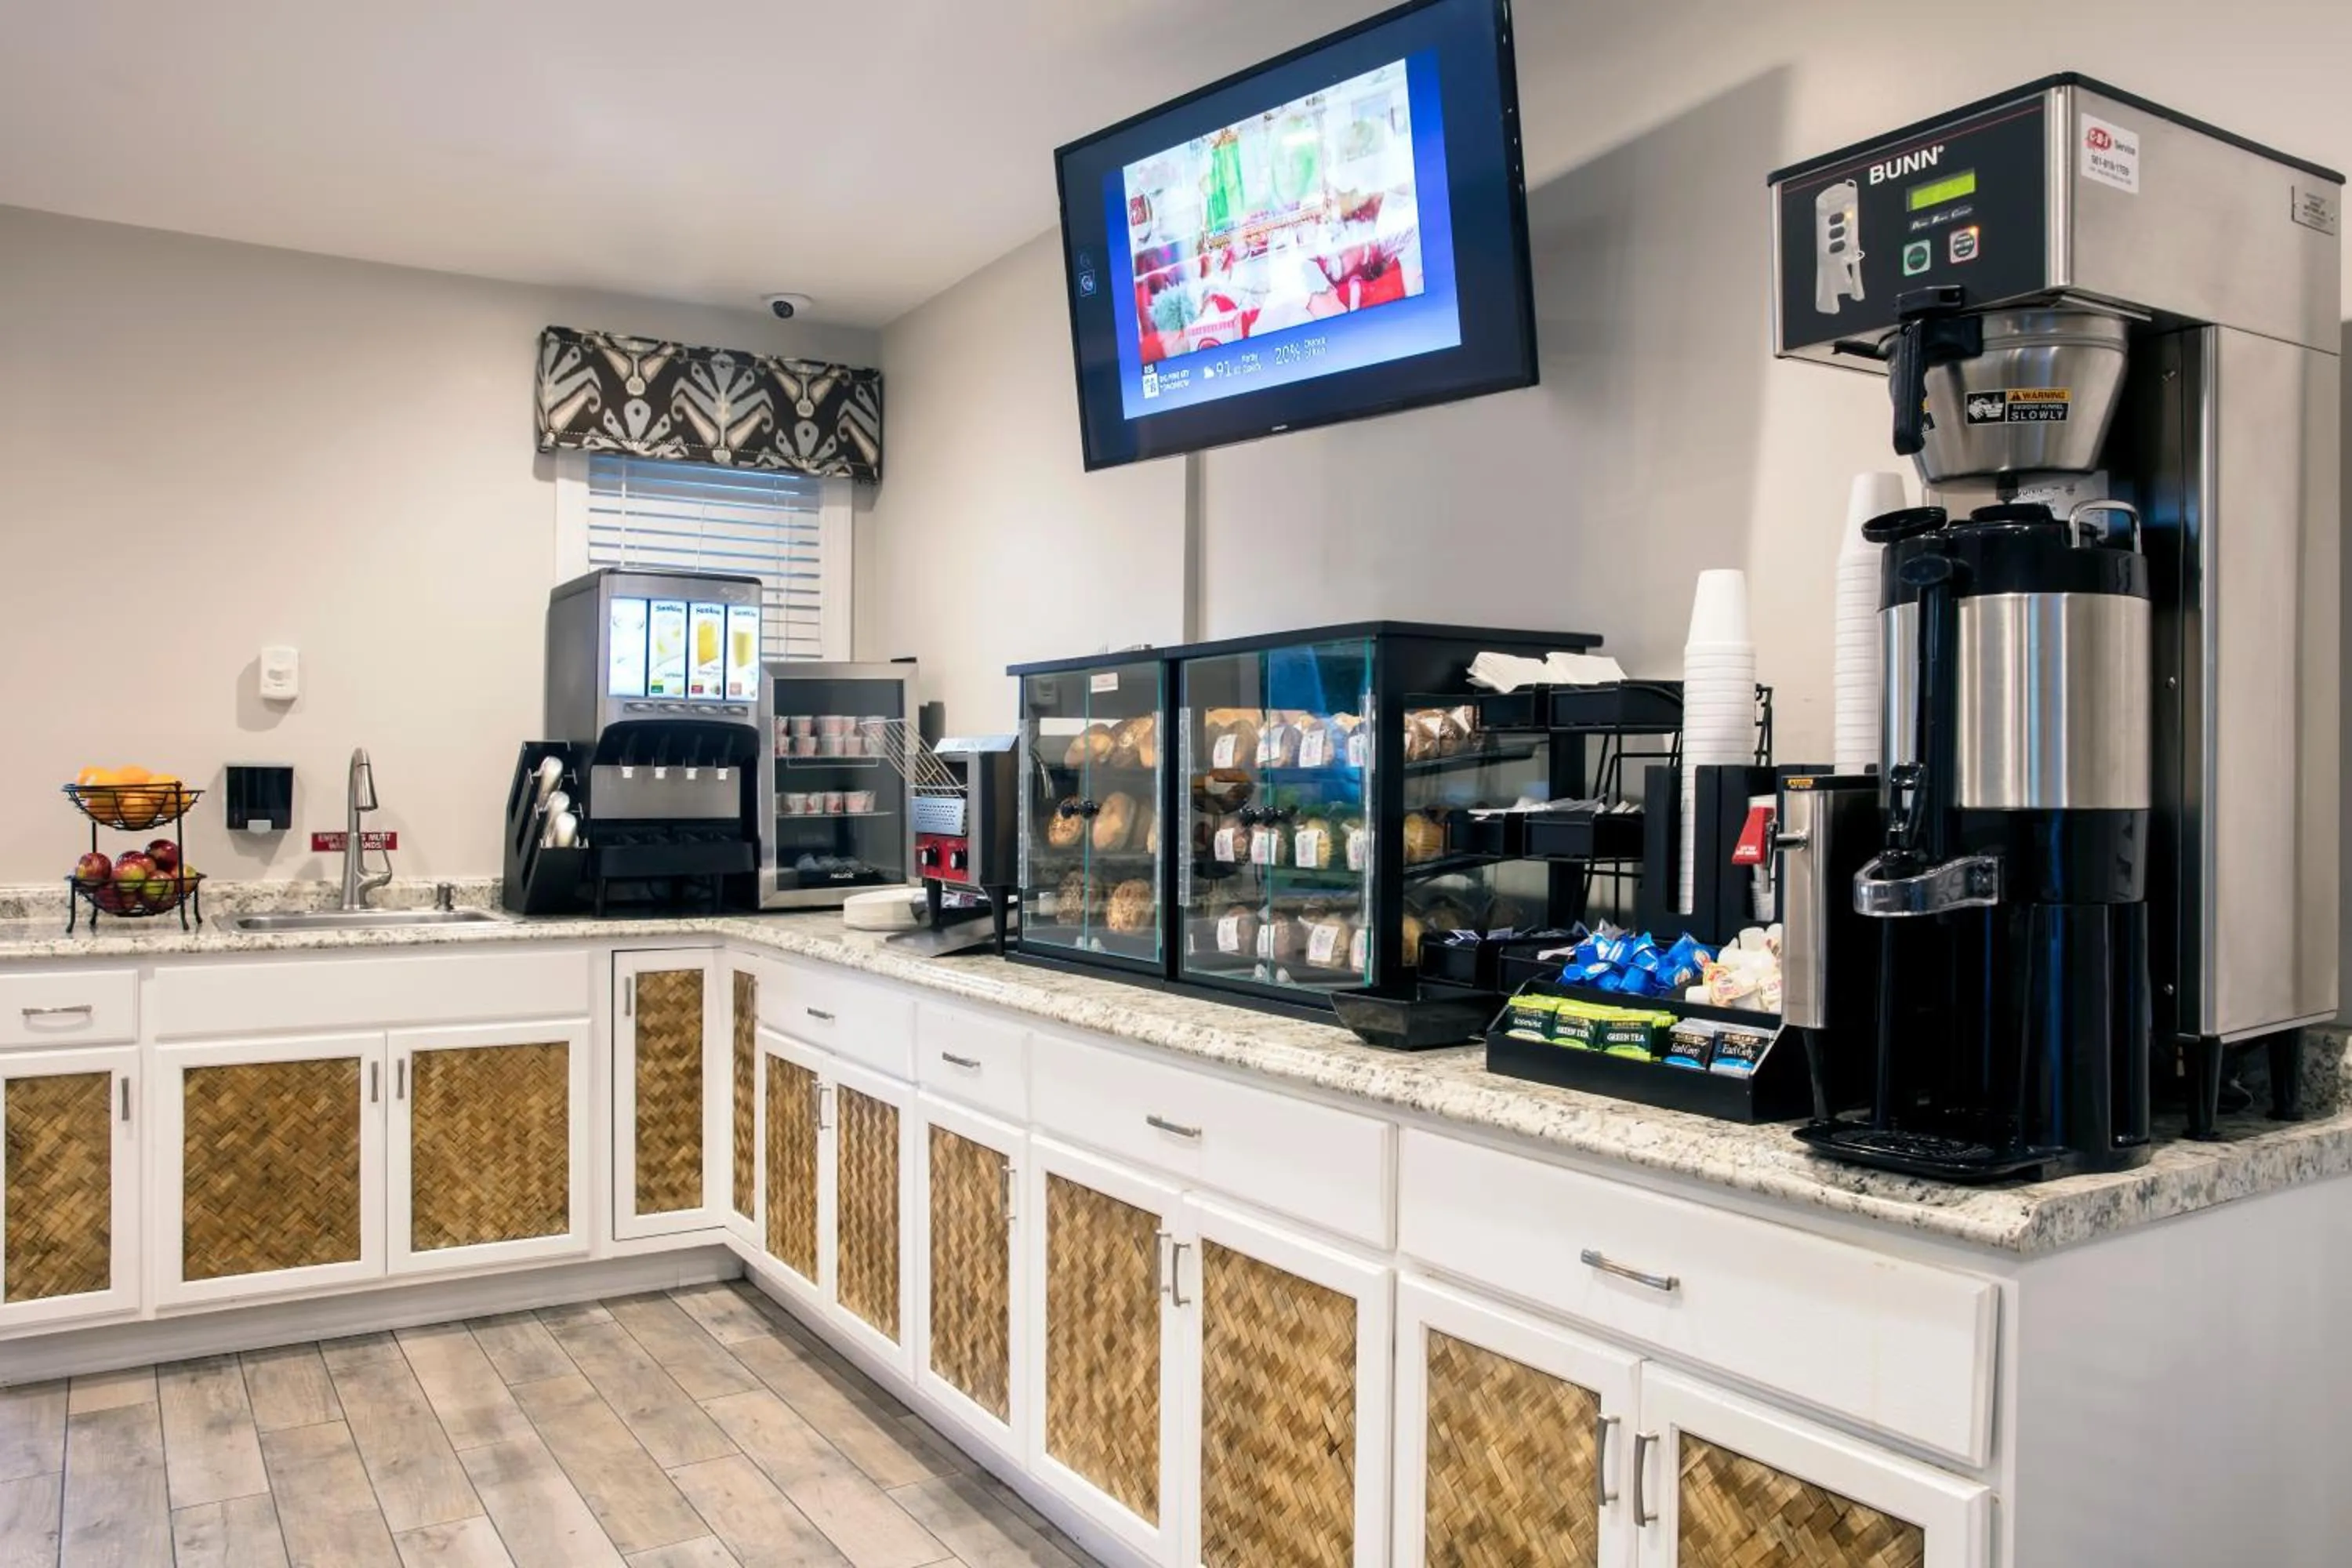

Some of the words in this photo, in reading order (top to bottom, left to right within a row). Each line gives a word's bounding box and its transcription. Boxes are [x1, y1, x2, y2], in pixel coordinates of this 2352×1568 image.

[1869, 145, 1938, 185] BUNN
[2023, 391, 2067, 400] WARNING
[2010, 410, 2063, 421] SLOWLY
[1607, 1033, 1630, 1041] GREEN
[1630, 1033, 1646, 1042] TEA
